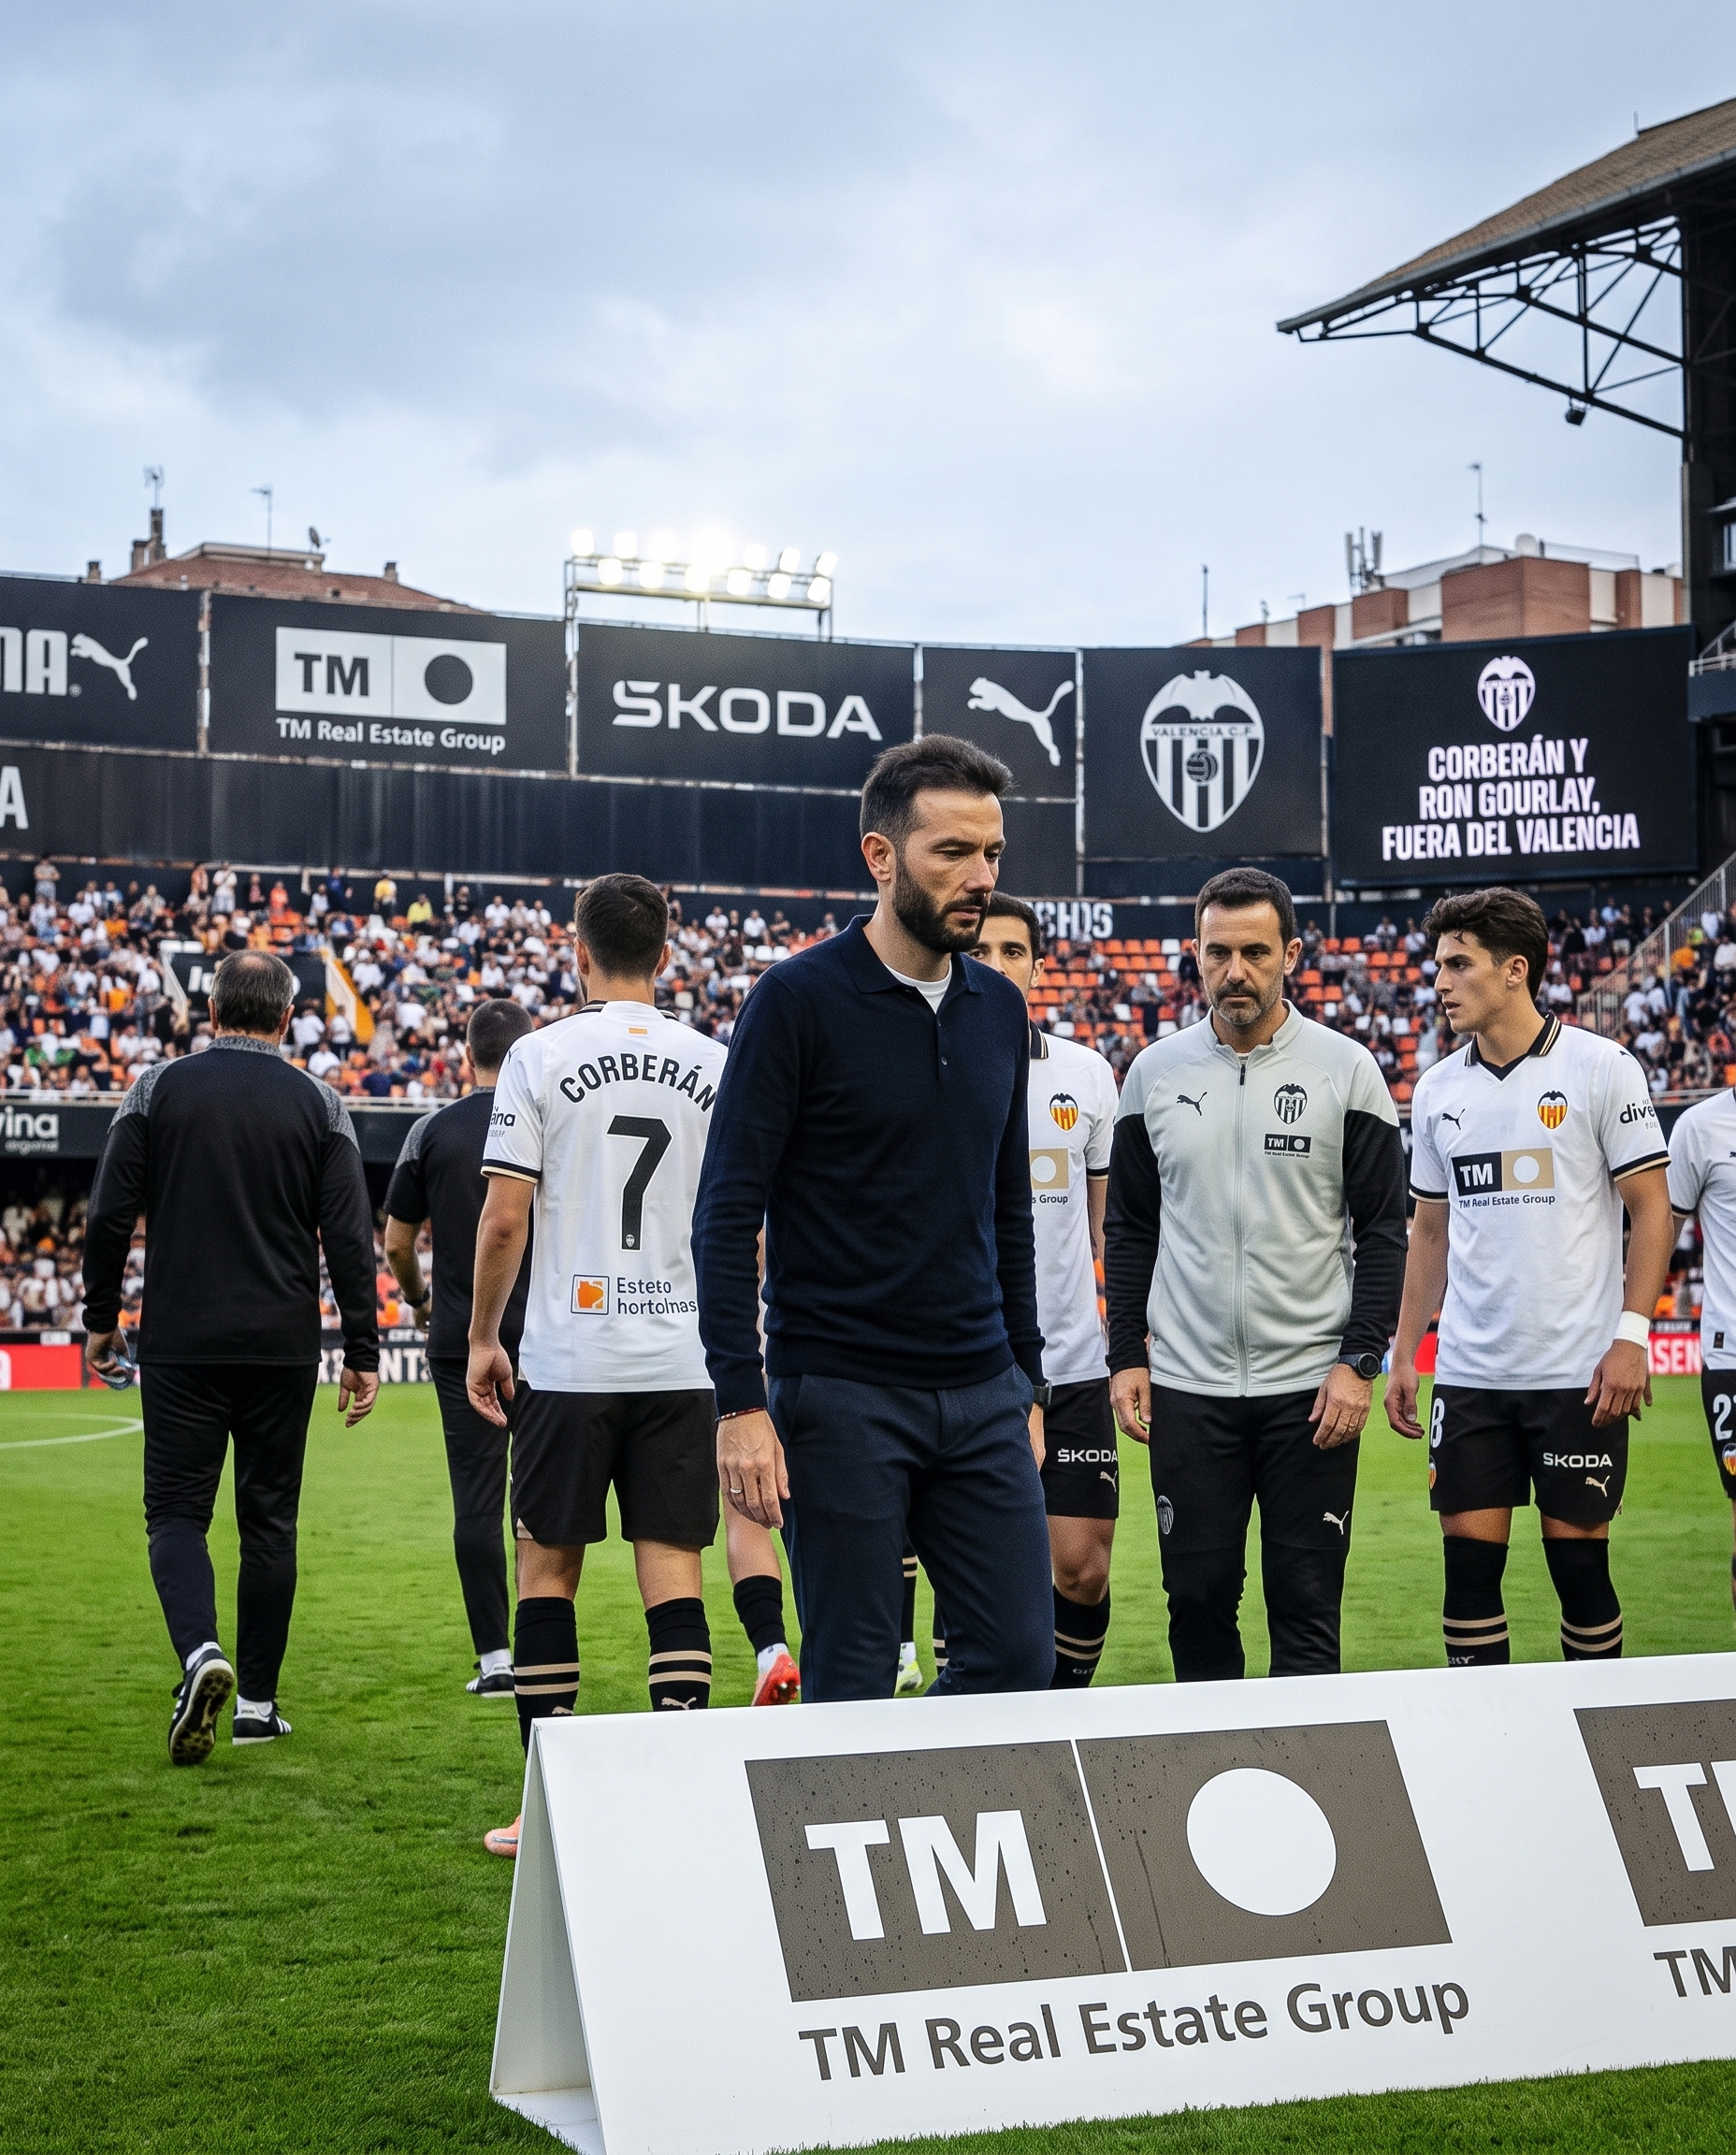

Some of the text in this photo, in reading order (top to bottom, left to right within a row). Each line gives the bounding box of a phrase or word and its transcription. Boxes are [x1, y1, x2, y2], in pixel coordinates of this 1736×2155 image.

[295, 653, 369, 697] TM
[276, 717, 506, 755] TM Real Estate Group
[1152, 727, 1222, 736] VALENCIA
[1427, 734, 1589, 782] CORBERÁN Y
[1419, 776, 1600, 820] RON GOURLAY,
[1382, 813, 1641, 861] FUERA DEL VALENCIA
[559, 1052, 717, 1113] CORBERÁN
[1267, 1137, 1284, 1149] TM
[606, 1114, 673, 1251] 7
[1459, 1163, 1494, 1188] TM
[1039, 1193, 1068, 1206] Group
[1459, 1199, 1470, 1209] TM
[1492, 1196, 1520, 1206] Estate
[1523, 1194, 1555, 1206] Group
[1713, 1394, 1736, 1440] 2
[1542, 1452, 1613, 1468] SKODA
[1632, 1759, 1736, 1873] T
[803, 1809, 1048, 1942] TM
[798, 1980, 1469, 2081] TM Real Estate Group
